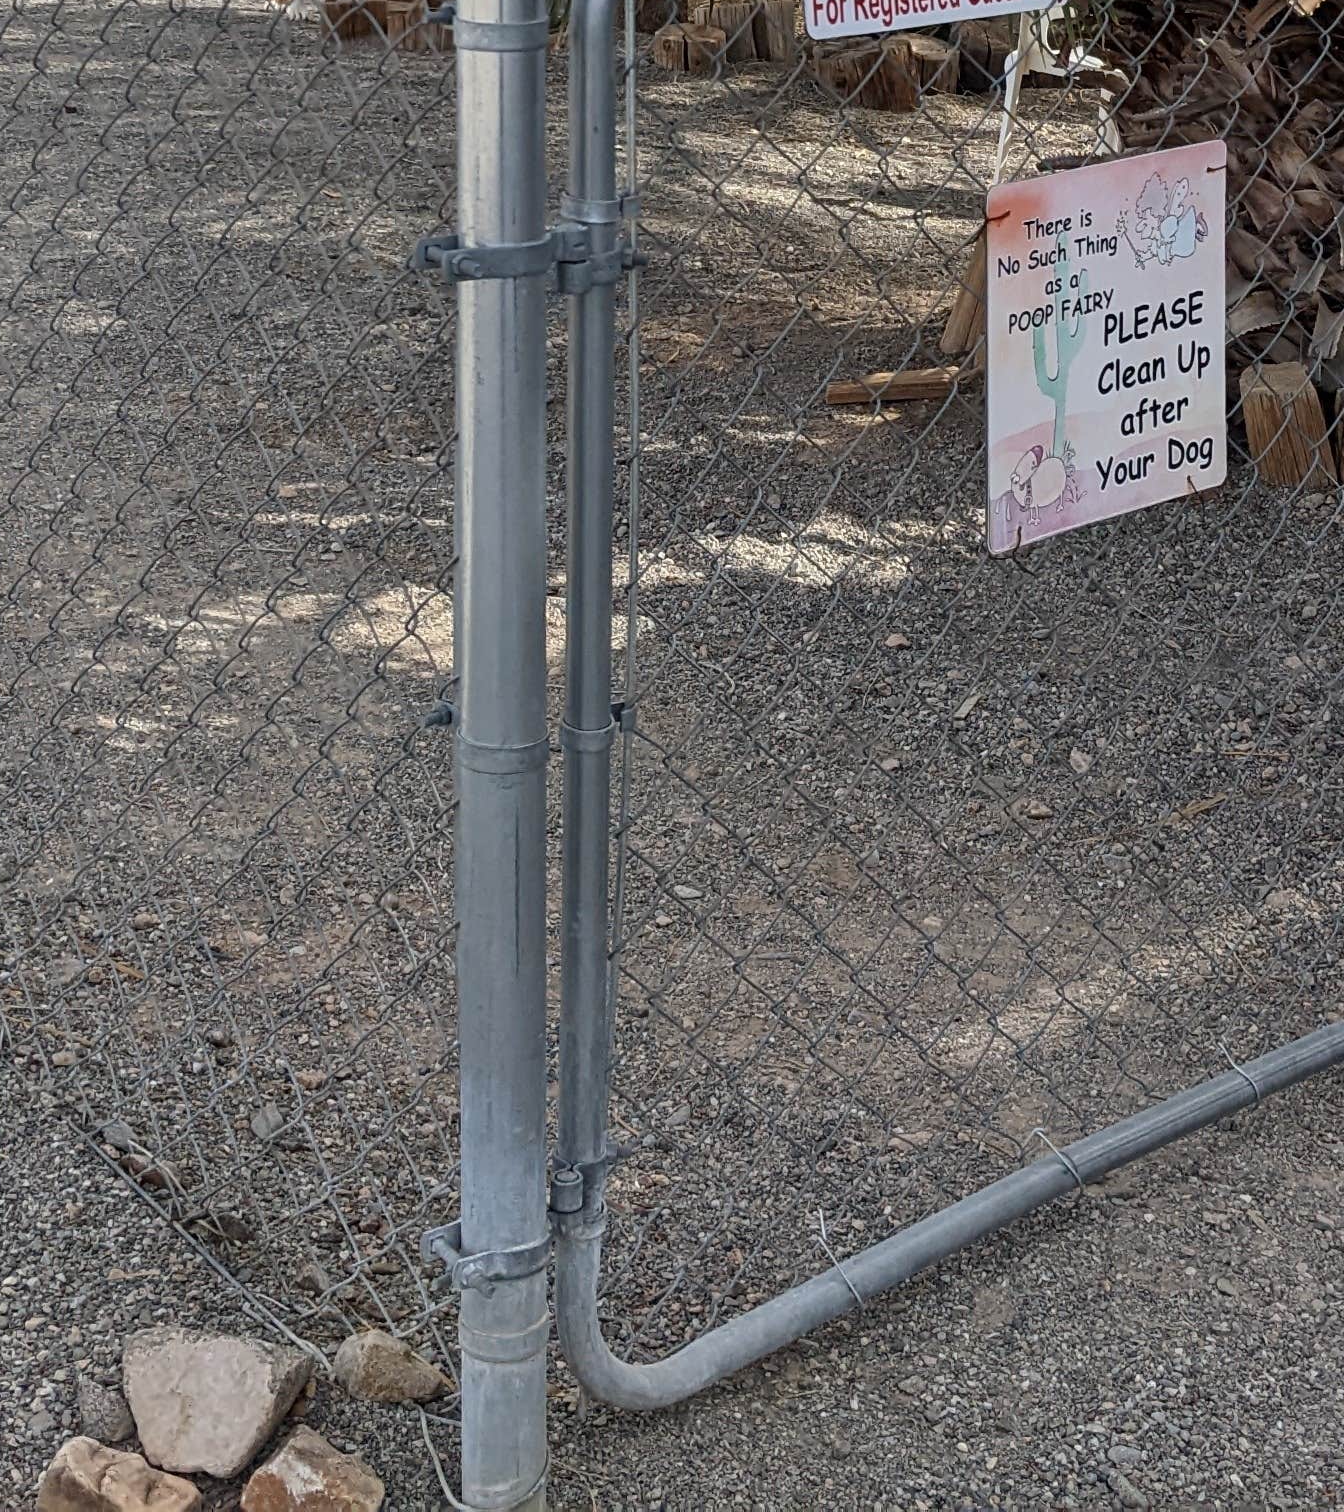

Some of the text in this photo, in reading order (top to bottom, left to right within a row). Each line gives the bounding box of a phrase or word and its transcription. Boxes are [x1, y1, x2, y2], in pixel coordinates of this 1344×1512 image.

[1023, 209, 1092, 240] There is
[997, 234, 1118, 278] No Such Thing
[1045, 274, 1079, 295] as a
[1009, 288, 1114, 335] POOP FAIRY
[1104, 290, 1204, 347] PLEASE
[1098, 340, 1211, 395] Clean Up
[1121, 397, 1189, 436] after
[1096, 437, 1214, 490] Your Dog
